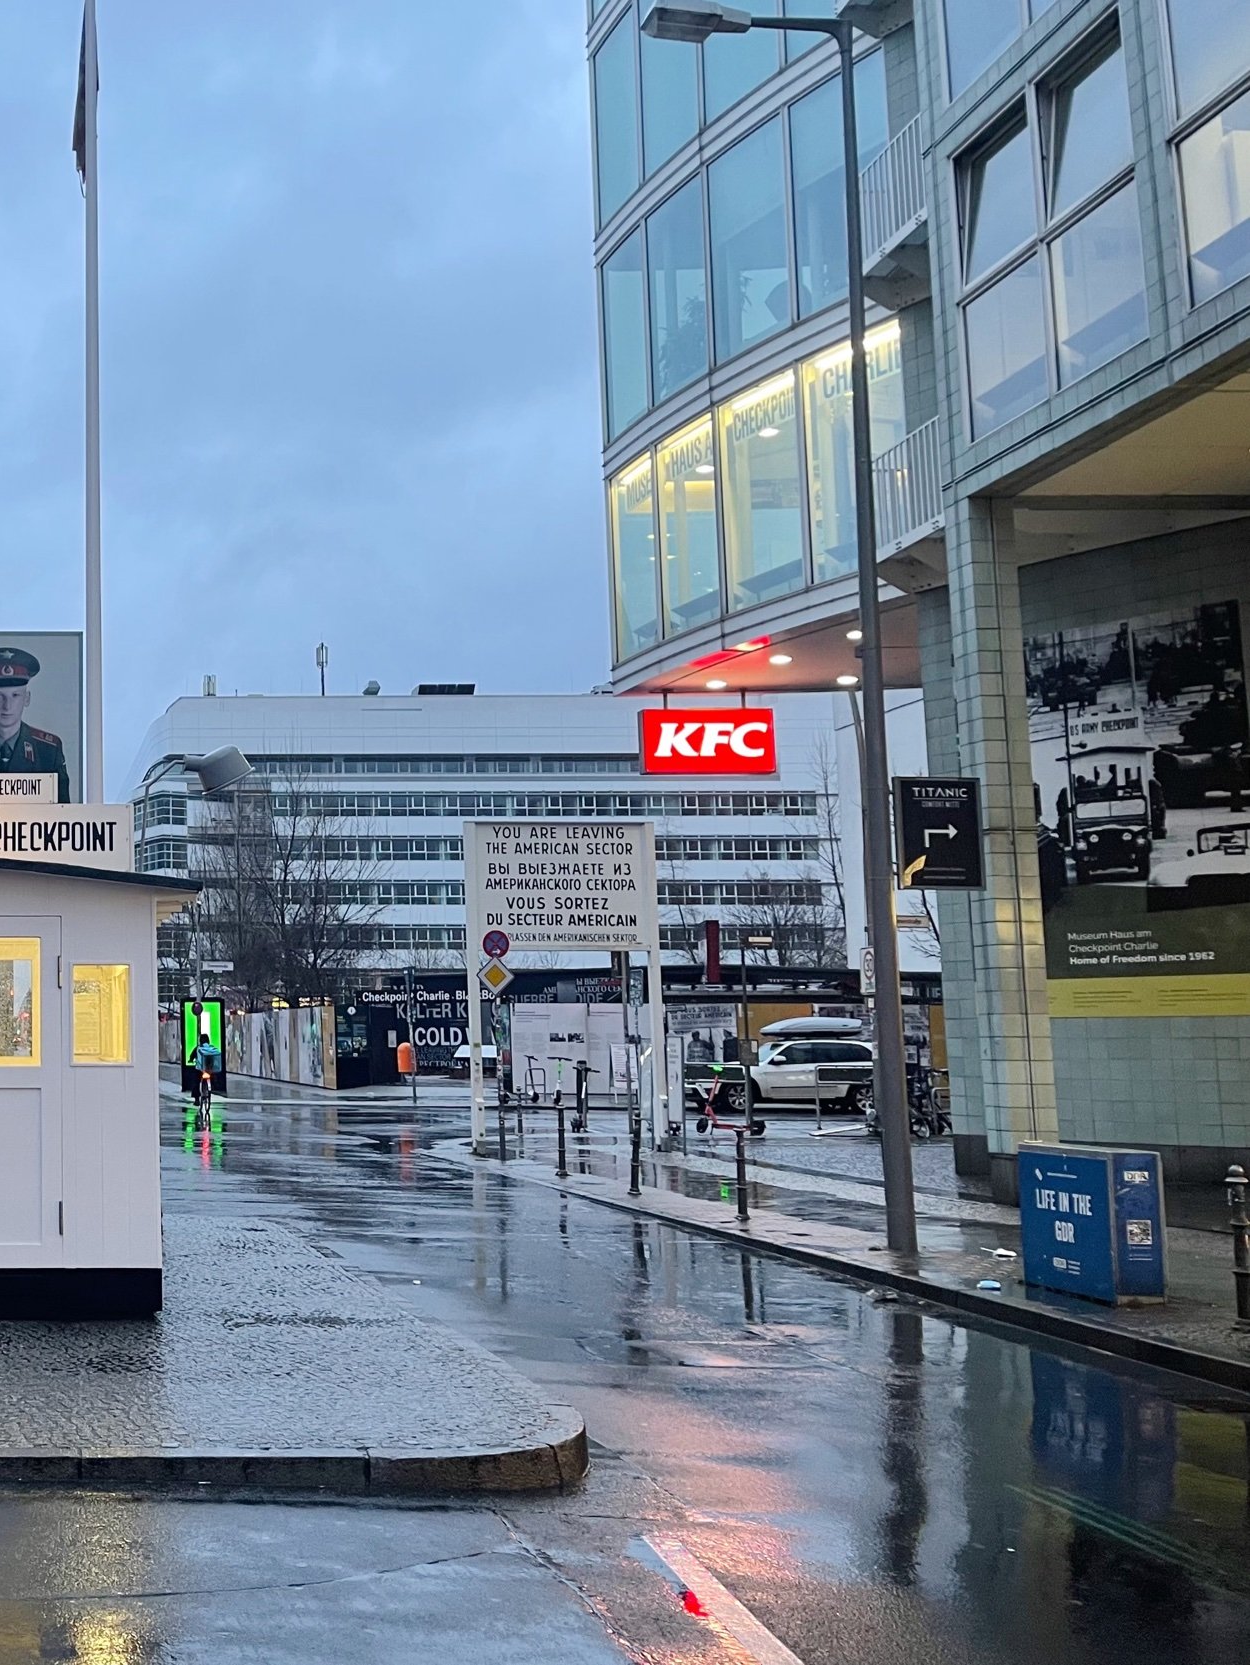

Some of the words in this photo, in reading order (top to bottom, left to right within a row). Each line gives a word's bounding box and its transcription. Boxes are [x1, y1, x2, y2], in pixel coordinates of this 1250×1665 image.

[822, 338, 901, 399] CHRLIE
[733, 387, 795, 442] CHECKPOI
[670, 437, 702, 478] HAUS
[626, 469, 652, 511] MUSE
[1081, 721, 1099, 734] ARMY
[1101, 716, 1139, 733] CHECKPOINT
[654, 722, 768, 758] KFC
[911, 787, 969, 798] TITANIC
[492, 826, 521, 839] YOU
[529, 826, 557, 839] ARE
[566, 826, 625, 839] LEAVING
[485, 842, 507, 854] THE
[514, 842, 579, 855] AMERICAN
[586, 843, 633, 855] SECTOR
[488, 863, 510, 875] ВЫ
[518, 863, 604, 876] ВЫЕЗЖАЕТЕ
[613, 863, 632, 876] ИЗ
[485, 878, 582, 891] АМЕРИКАНСКОГО
[586, 878, 636, 891] СЕКТОРА
[506, 897, 546, 910] VOUS
[554, 897, 609, 910] SORTEZ
[486, 913, 503, 926] DU
[507, 913, 563, 926] SECTEUR
[568, 914, 637, 927] AMERICAIN
[508, 932, 537, 942] RLASSEN
[538, 933, 551, 942] DEN
[553, 933, 611, 943] AMERIKANISCHEN
[612, 934, 638, 943] SEKTOR
[1067, 931, 1108, 941] Museum
[1109, 930, 1135, 939] Haus
[1136, 930, 1152, 938] am
[1068, 943, 1122, 953] Checkpoint
[1123, 941, 1159, 951] Charlie
[1069, 957, 1098, 965] Home
[1100, 955, 1111, 964] of
[1112, 954, 1157, 963] Freedom
[1158, 952, 1187, 962] since
[416, 990, 450, 1001] Charlie
[396, 1002, 452, 1019] KLTER
[414, 1027, 463, 1047] COLD
[1035, 1188, 1057, 1211] LIFE
[1058, 1191, 1070, 1213] IN
[1072, 1193, 1093, 1216] THE
[1054, 1220, 1075, 1244] GDR
